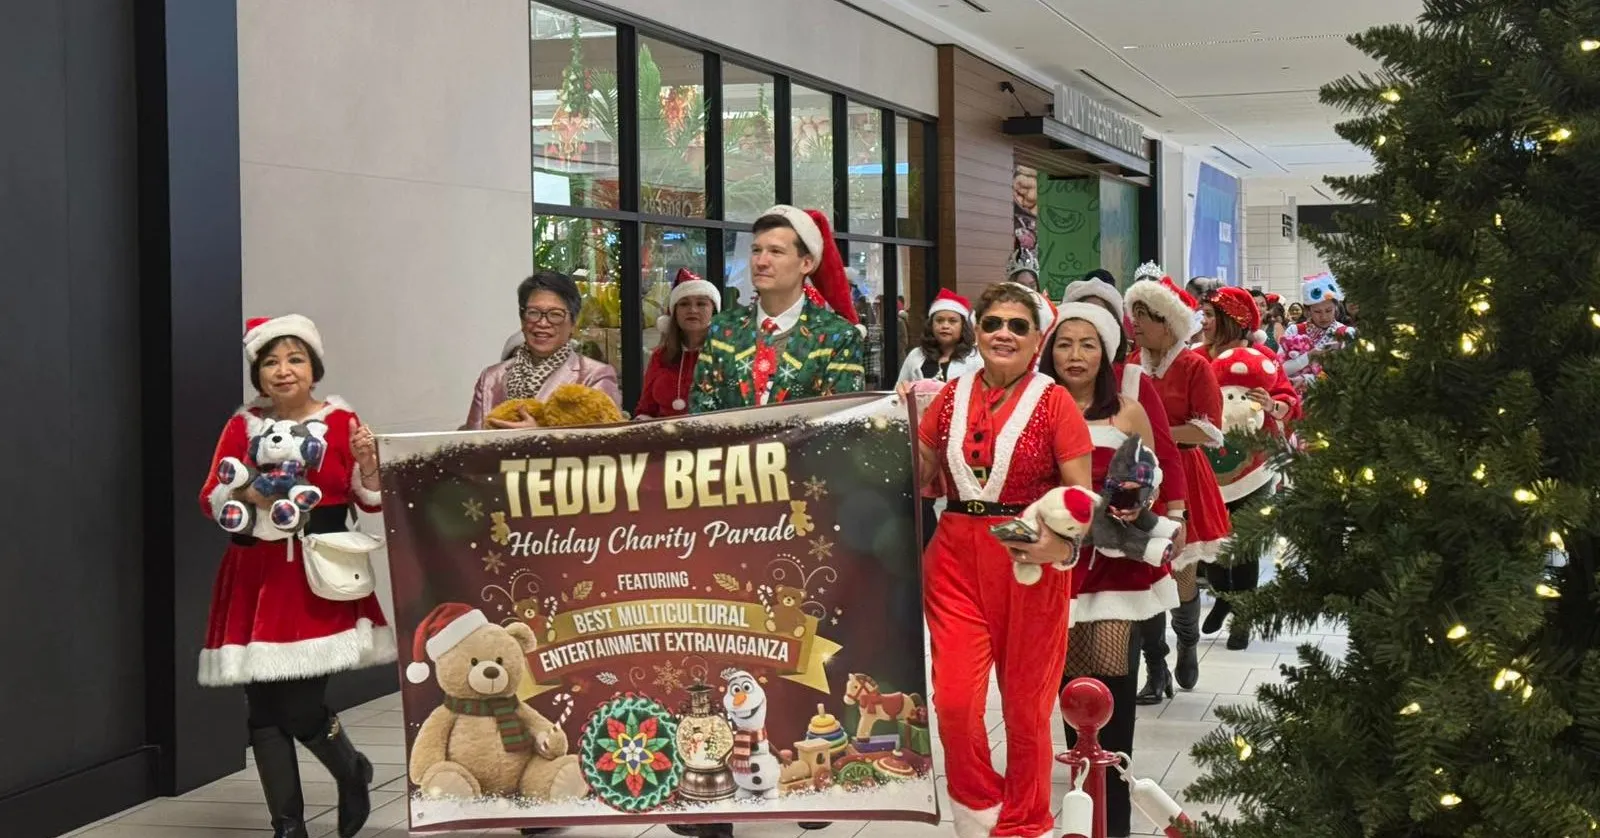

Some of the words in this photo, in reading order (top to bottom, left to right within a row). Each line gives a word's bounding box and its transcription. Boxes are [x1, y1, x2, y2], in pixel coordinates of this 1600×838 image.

[1060, 83, 1086, 133] DAILY
[1088, 98, 1113, 146] FRESH
[1113, 111, 1145, 158] PRODUCE
[500, 452, 649, 518] TEDDY
[663, 442, 790, 510] BEAR
[507, 527, 600, 564] Holiday
[607, 524, 696, 559] Charity
[703, 514, 795, 547] Parade
[617, 571, 689, 591] FEATURING
[573, 609, 617, 633] BEST
[617, 603, 749, 628] MULTICULTURAL
[539, 632, 661, 672] ENTERTAINMENT
[665, 632, 788, 662] EXTRAVAGANZA
